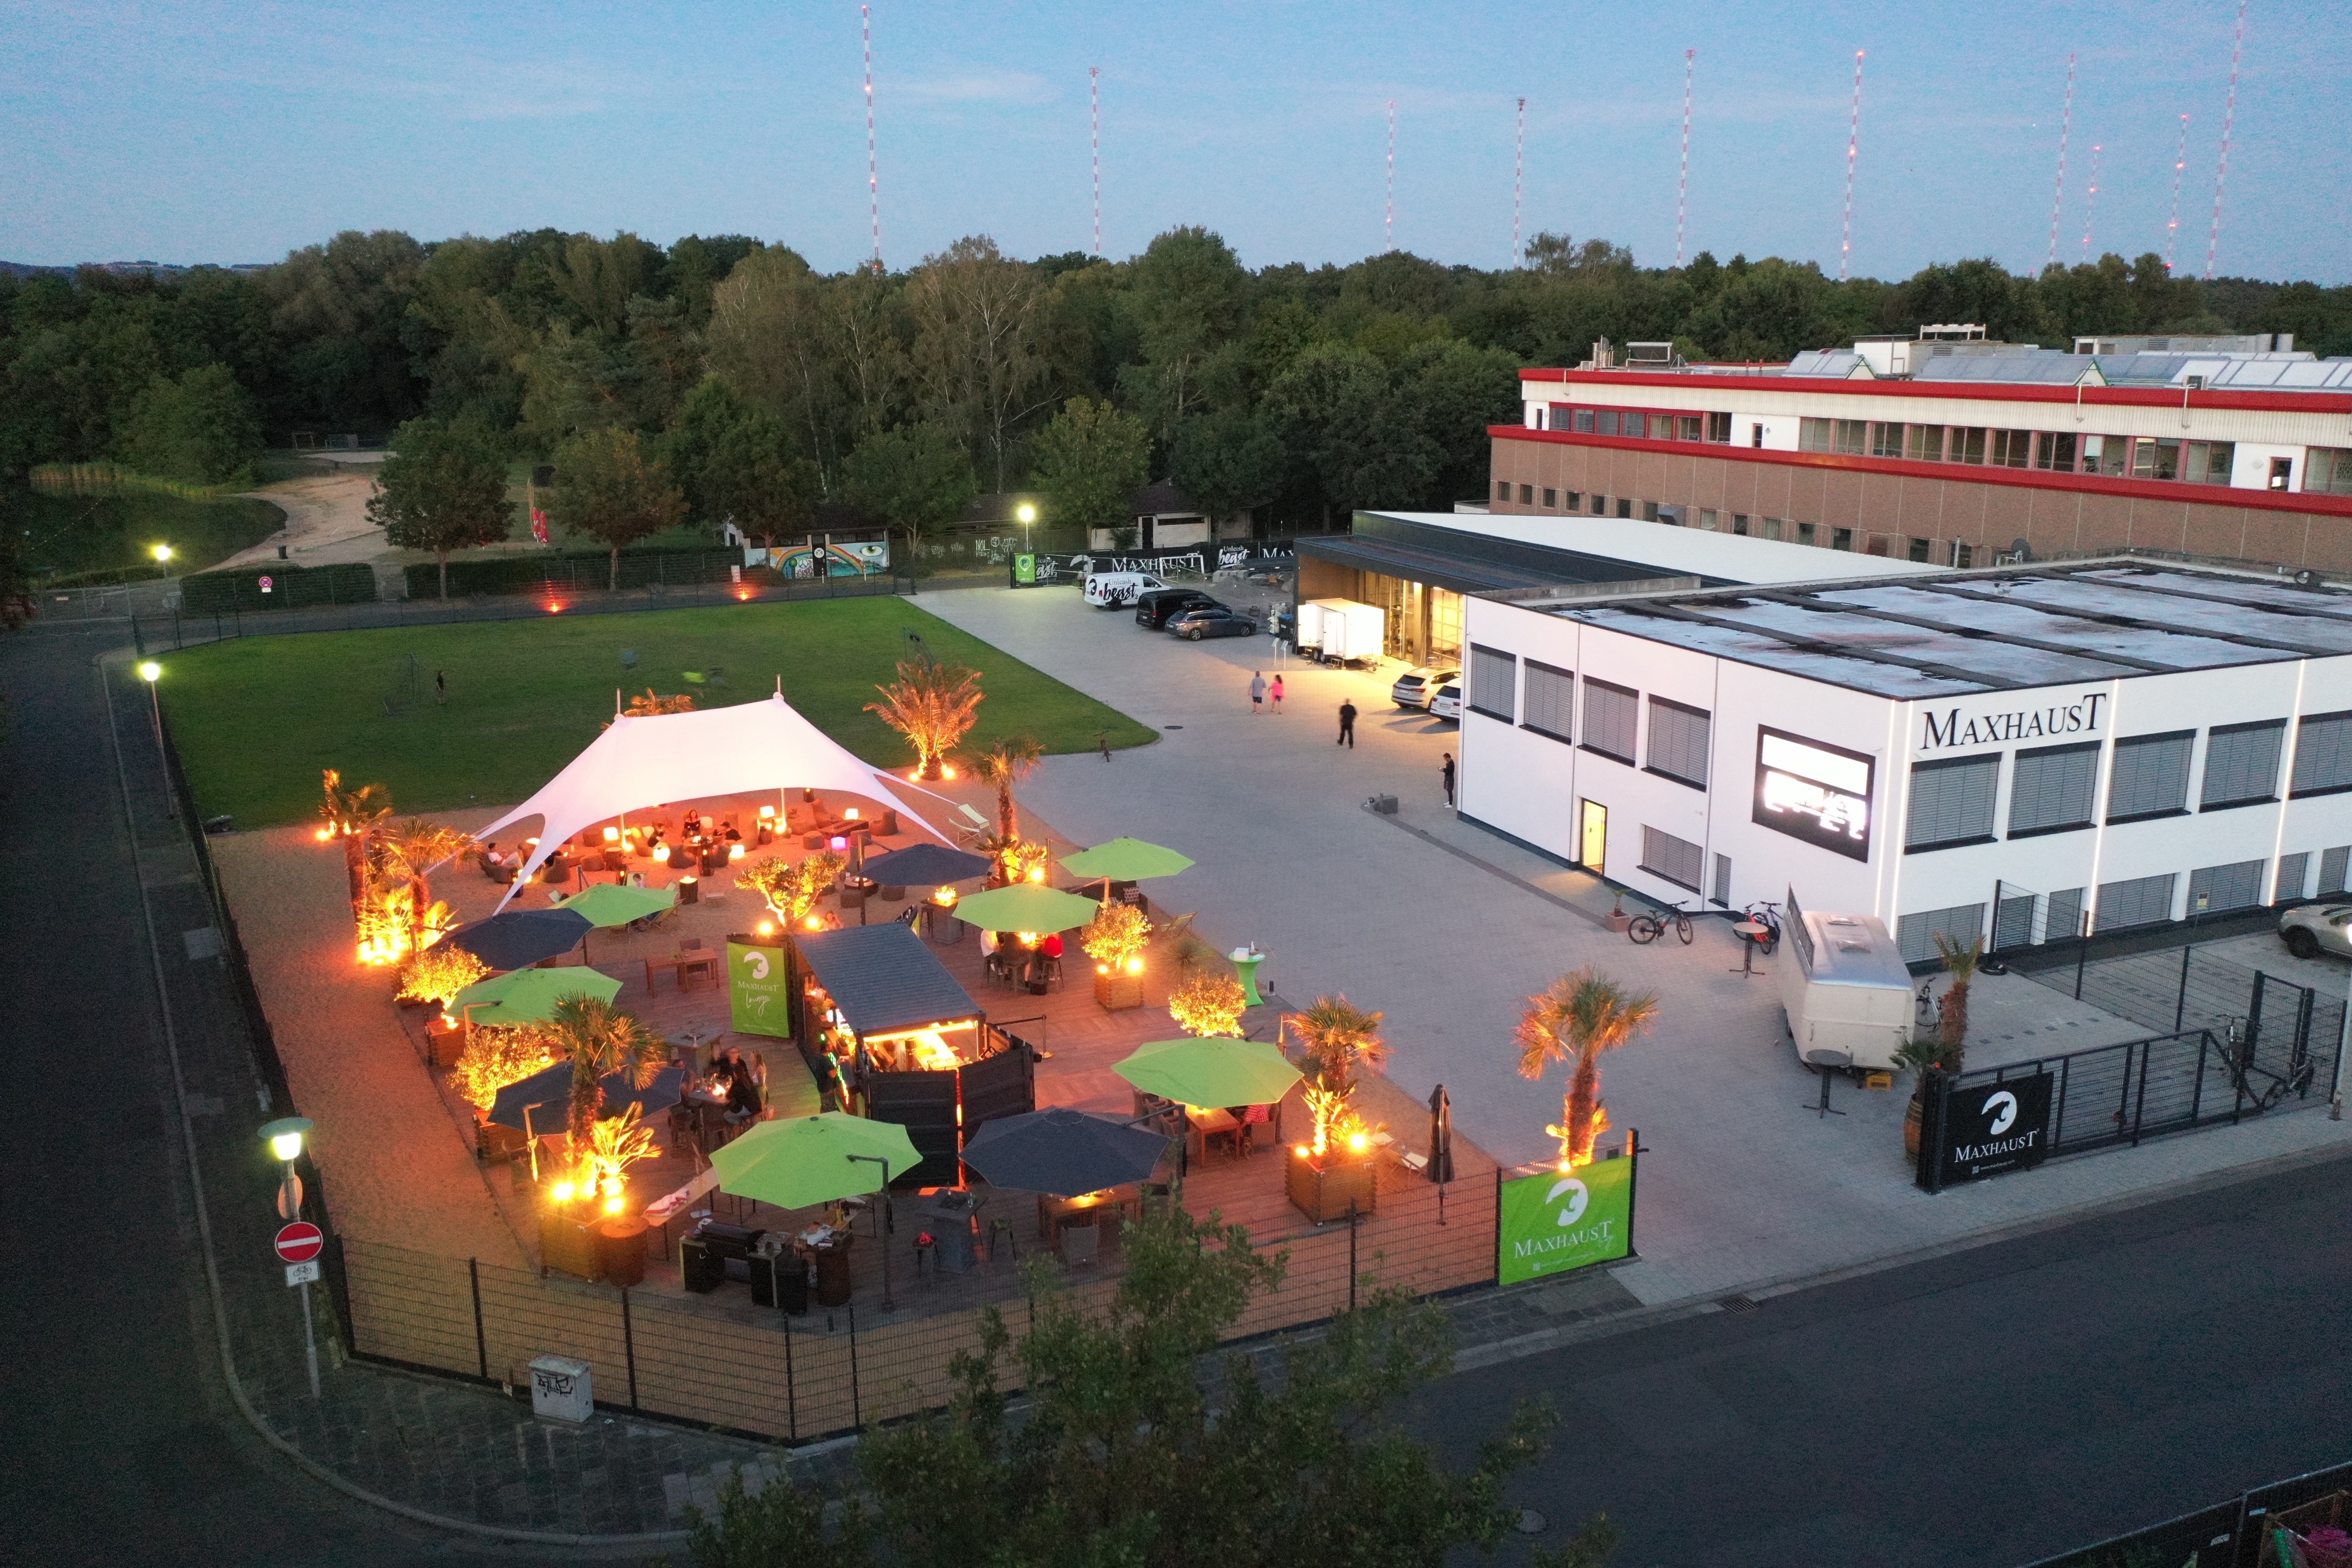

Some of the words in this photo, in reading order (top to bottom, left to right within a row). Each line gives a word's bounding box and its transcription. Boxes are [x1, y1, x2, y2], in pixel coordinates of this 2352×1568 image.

[1112, 553, 1198, 573] MAXHAUST
[1218, 549, 1250, 565] beast
[1103, 582, 1139, 601] beast
[1920, 692, 2107, 750] MAXHAUST
[738, 980, 779, 992] MAXHAUST
[746, 991, 771, 1017] Lounge
[1954, 1130, 2037, 1163] MAXHAUST
[1514, 1220, 1613, 1259] MAXHAUST
